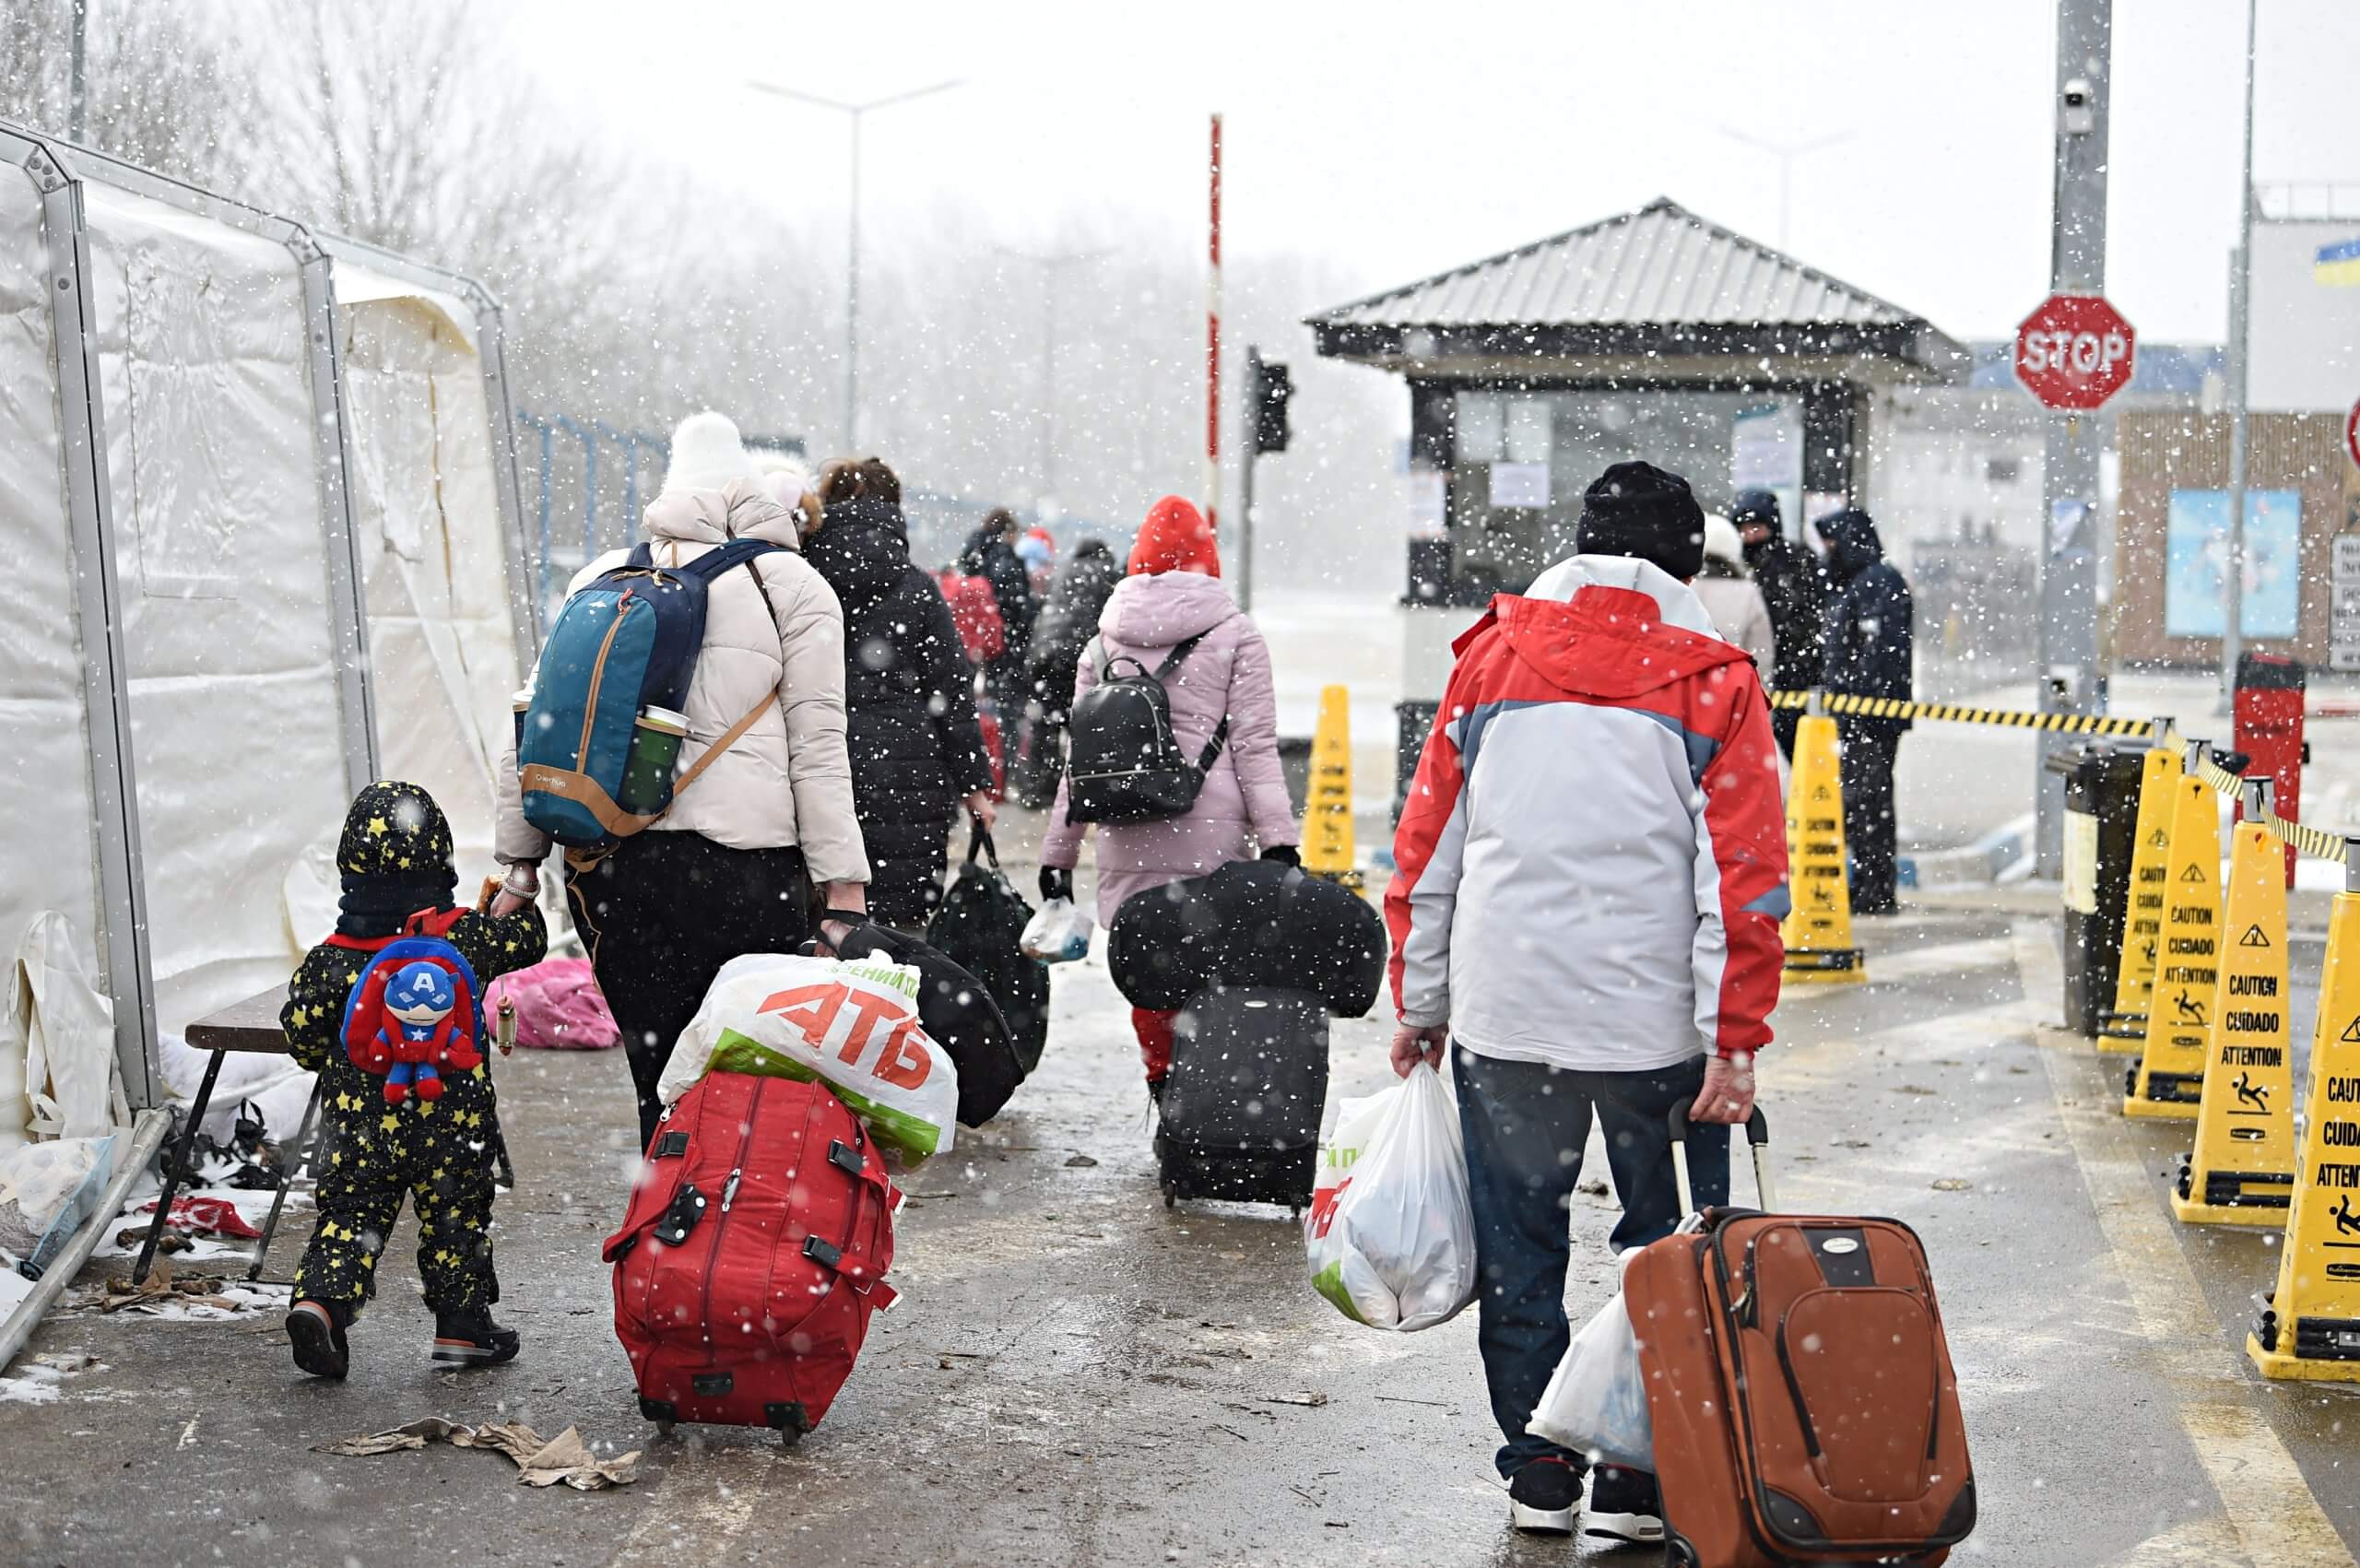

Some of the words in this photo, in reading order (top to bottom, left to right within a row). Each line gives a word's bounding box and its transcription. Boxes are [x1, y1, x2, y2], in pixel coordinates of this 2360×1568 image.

[2025, 330, 2126, 373] STOP
[2171, 906, 2212, 925] CAUTION
[2168, 937, 2214, 956] CUIDADO
[412, 973, 436, 993] A
[2165, 966, 2217, 985] ATTENTION
[2229, 974, 2278, 997] CAUTION
[2226, 1011, 2280, 1033] CUIDADO
[756, 981, 933, 1091] АТБ
[2221, 1046, 2283, 1067] ATTENTION
[2328, 1076, 2360, 1102] CAUT
